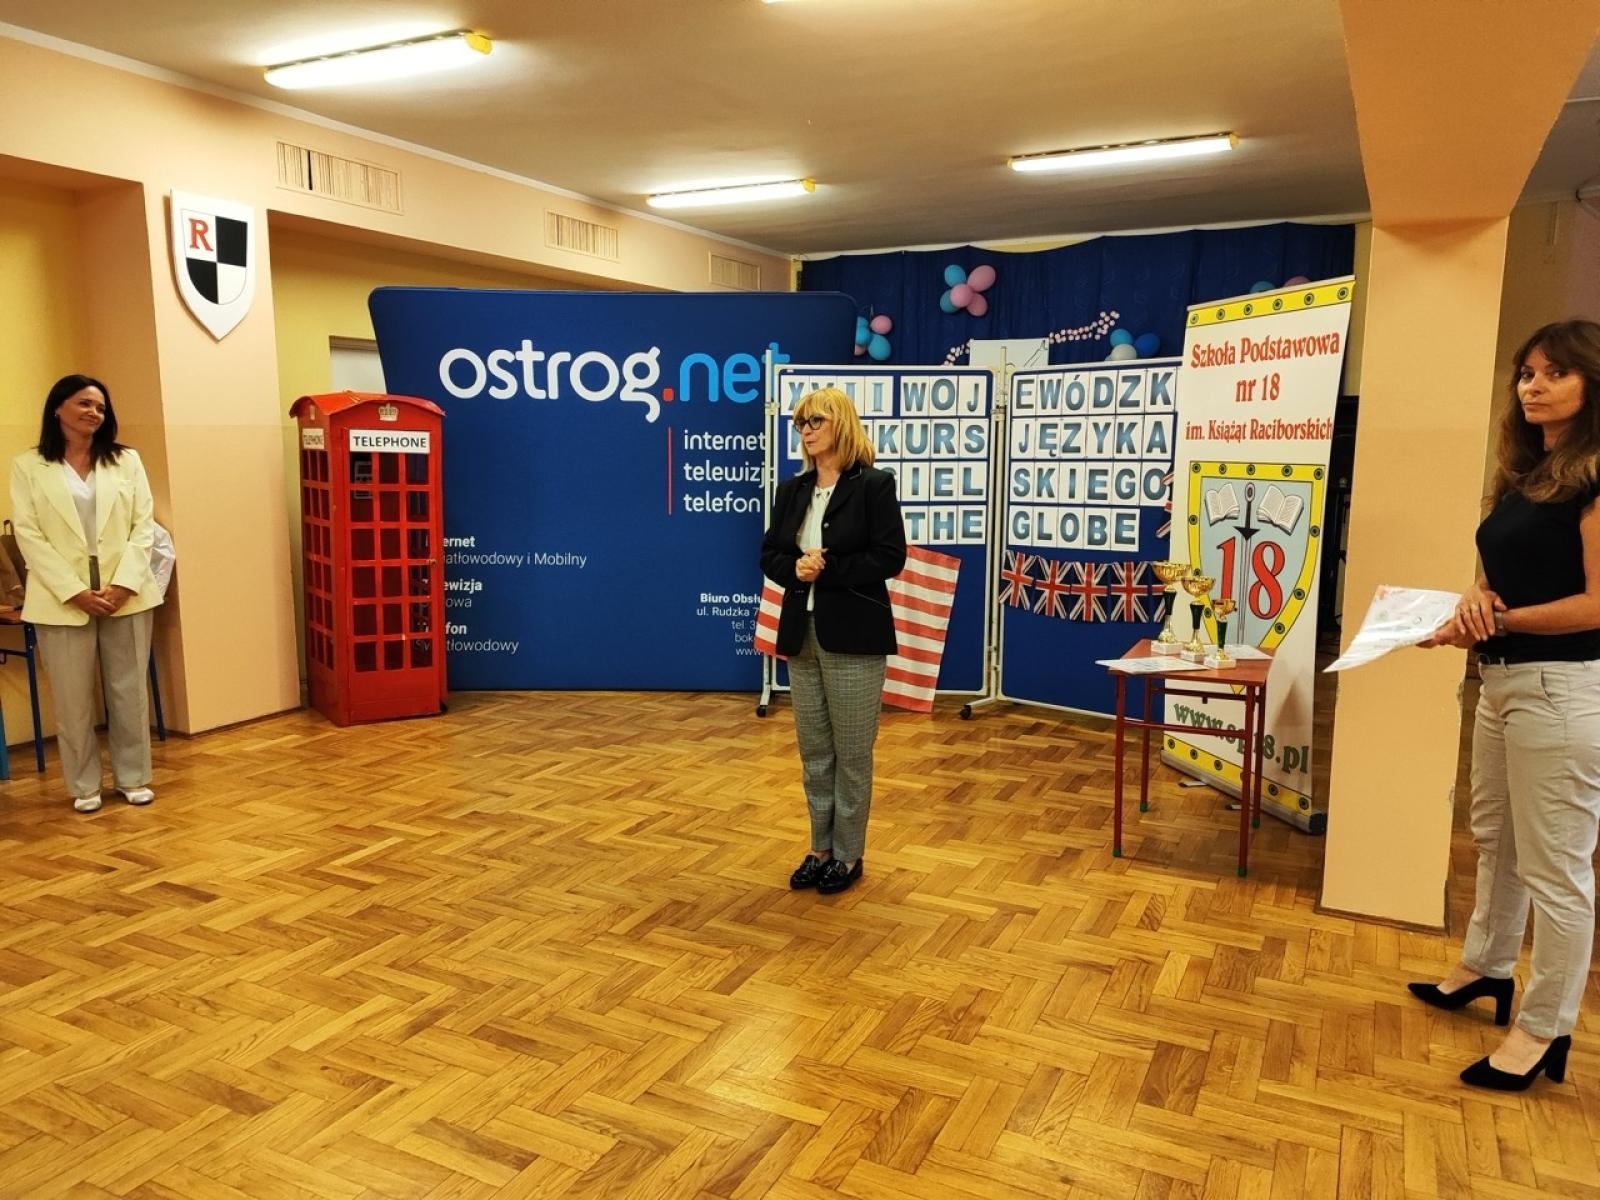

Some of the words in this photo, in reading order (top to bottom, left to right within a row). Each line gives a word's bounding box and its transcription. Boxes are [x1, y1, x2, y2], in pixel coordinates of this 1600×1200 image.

[188, 217, 214, 252] R
[1190, 341, 1236, 369] Szkoła
[1240, 332, 1340, 363] Podstawowa
[903, 378, 979, 412] WOJ
[1016, 372, 1173, 411] EWÓDZK
[1235, 378, 1257, 402] nr
[1262, 372, 1281, 401] 18
[353, 436, 427, 448] TELEPHONE
[684, 429, 765, 450] internet
[1018, 421, 1168, 457] JĘZYKA
[1185, 420, 1205, 441] im.
[1208, 418, 1247, 444] Książąt
[1250, 417, 1333, 441] Raciborskich
[683, 459, 766, 488] telewizj
[1013, 468, 1168, 500] SKIEGO
[683, 490, 761, 513] telefon
[905, 510, 984, 540] THE
[1012, 511, 1137, 546] GLOBE
[527, 552, 531, 565] i
[534, 552, 587, 569] Mobilny
[696, 606, 709, 616] ul.
[712, 606, 750, 617] Rudzka
[700, 593, 730, 604] Biuro
